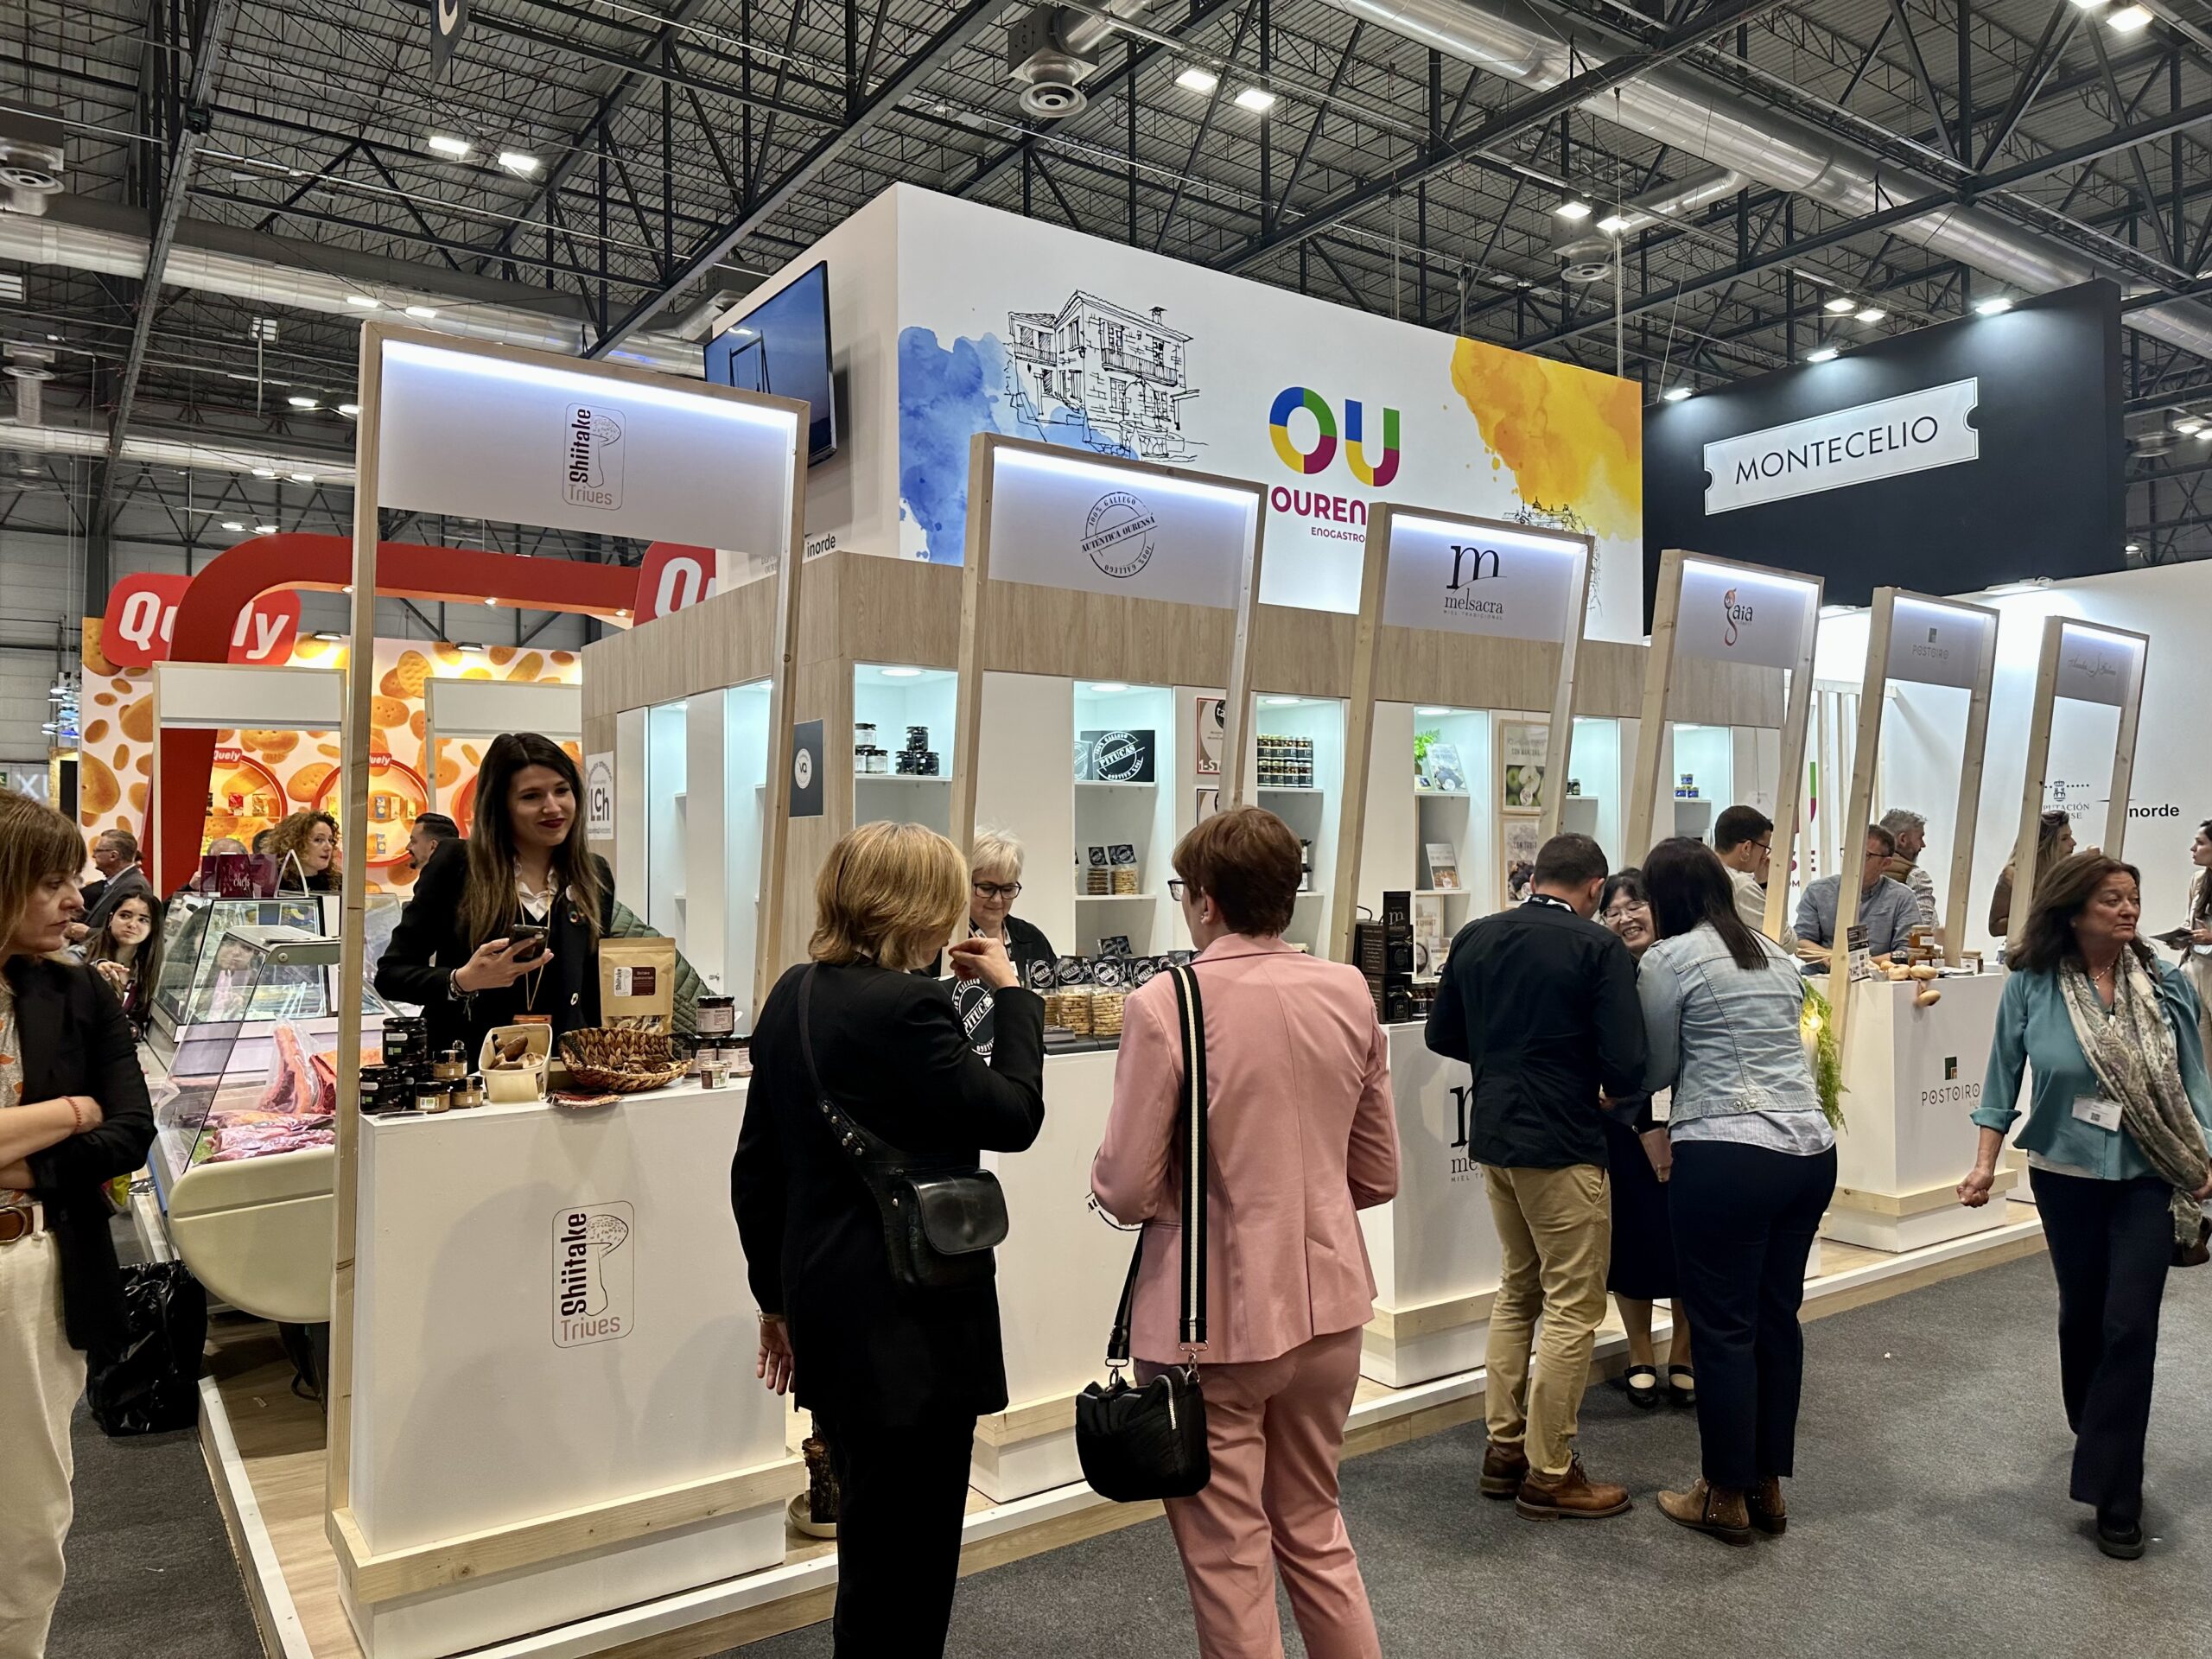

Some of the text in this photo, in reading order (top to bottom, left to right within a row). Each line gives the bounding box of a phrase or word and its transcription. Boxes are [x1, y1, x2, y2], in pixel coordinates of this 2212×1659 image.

[569, 409, 591, 483] Shiitake
[1269, 386, 1400, 486] OU
[1735, 416, 1938, 485] MONTECELIO
[1103, 496, 1136, 507] GALLEGO
[807, 533, 836, 558] inorde
[1082, 530, 1122, 553] AUTÉNTICA
[1444, 588, 1503, 614] melsacra
[118, 591, 290, 660] Qly
[369, 755, 391, 766] uely
[1098, 744, 1136, 767] PITUCAS
[1922, 1083, 1980, 1106] POSTOIRO
[561, 1213, 587, 1316] Shiitake
